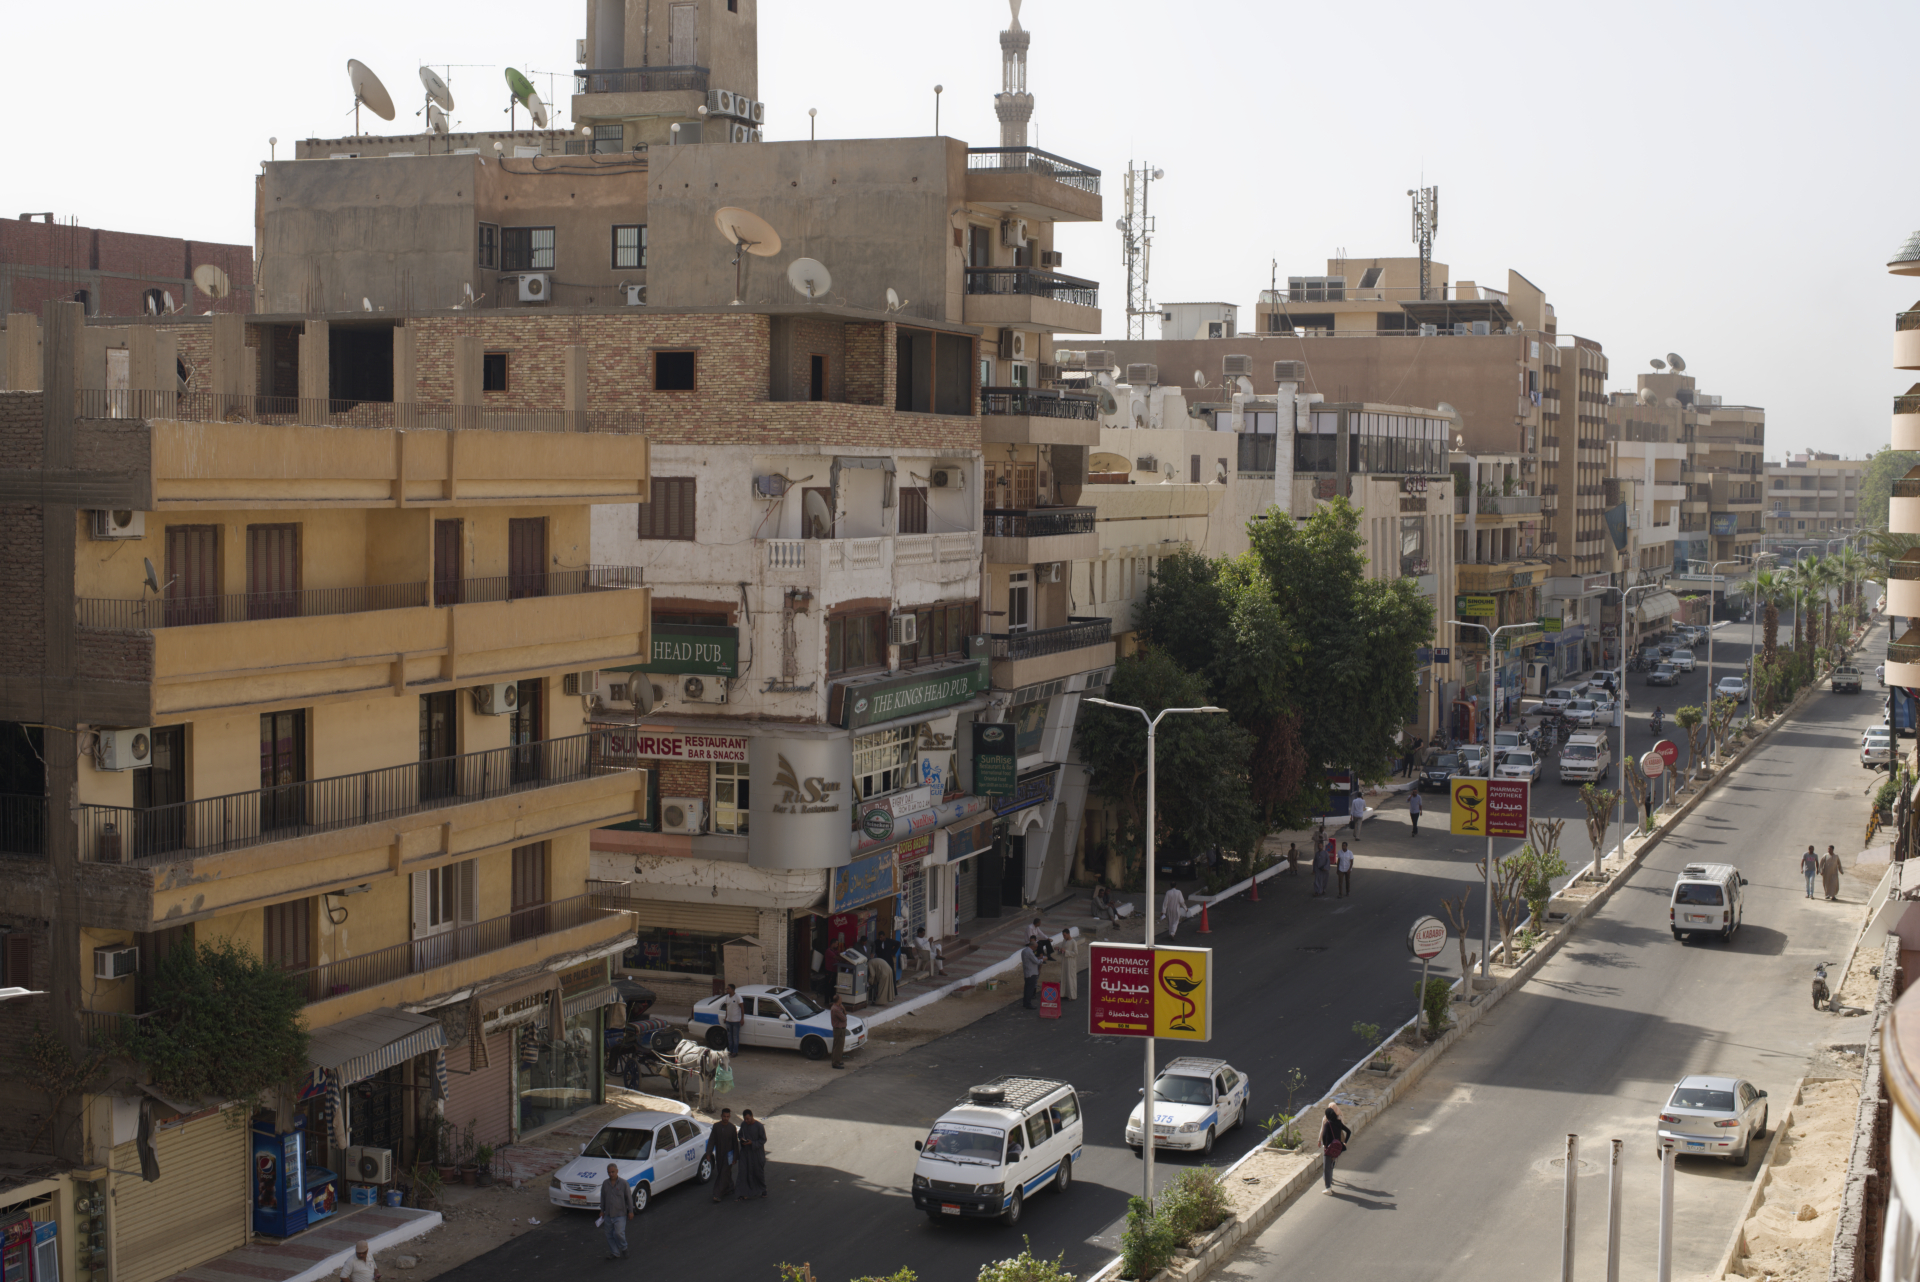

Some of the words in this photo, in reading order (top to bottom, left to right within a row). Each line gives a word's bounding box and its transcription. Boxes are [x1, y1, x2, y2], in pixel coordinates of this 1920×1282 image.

[653, 641, 692, 660] HEAD
[695, 643, 721, 662] PUB
[873, 694, 894, 714] THE
[894, 686, 923, 710] KINGS
[923, 682, 950, 703] HEAD
[951, 677, 968, 697] PUB
[612, 735, 683, 756] SUNRISE
[685, 735, 748, 749] RESTAURANT
[688, 749, 704, 758] BAR
[706, 750, 712, 758] &
[713, 750, 745, 761] SNACKS
[980, 754, 1012, 764] SunRise
[804, 777, 840, 803] Sun
[892, 796, 905, 808] EVERY
[905, 793, 914, 805] DAY
[1489, 800, 1523, 811] صيدلية
[772, 804, 788, 814] Bar
[1101, 956, 1150, 966] PHARMACY
[1101, 965, 1149, 975] APOTHEKE
[1100, 977, 1149, 995] صيدلية
[1117, 996, 1138, 1006] باسم
[1108, 1009, 1130, 1018] متميزة
[1130, 1010, 1149, 1018] خدمة
